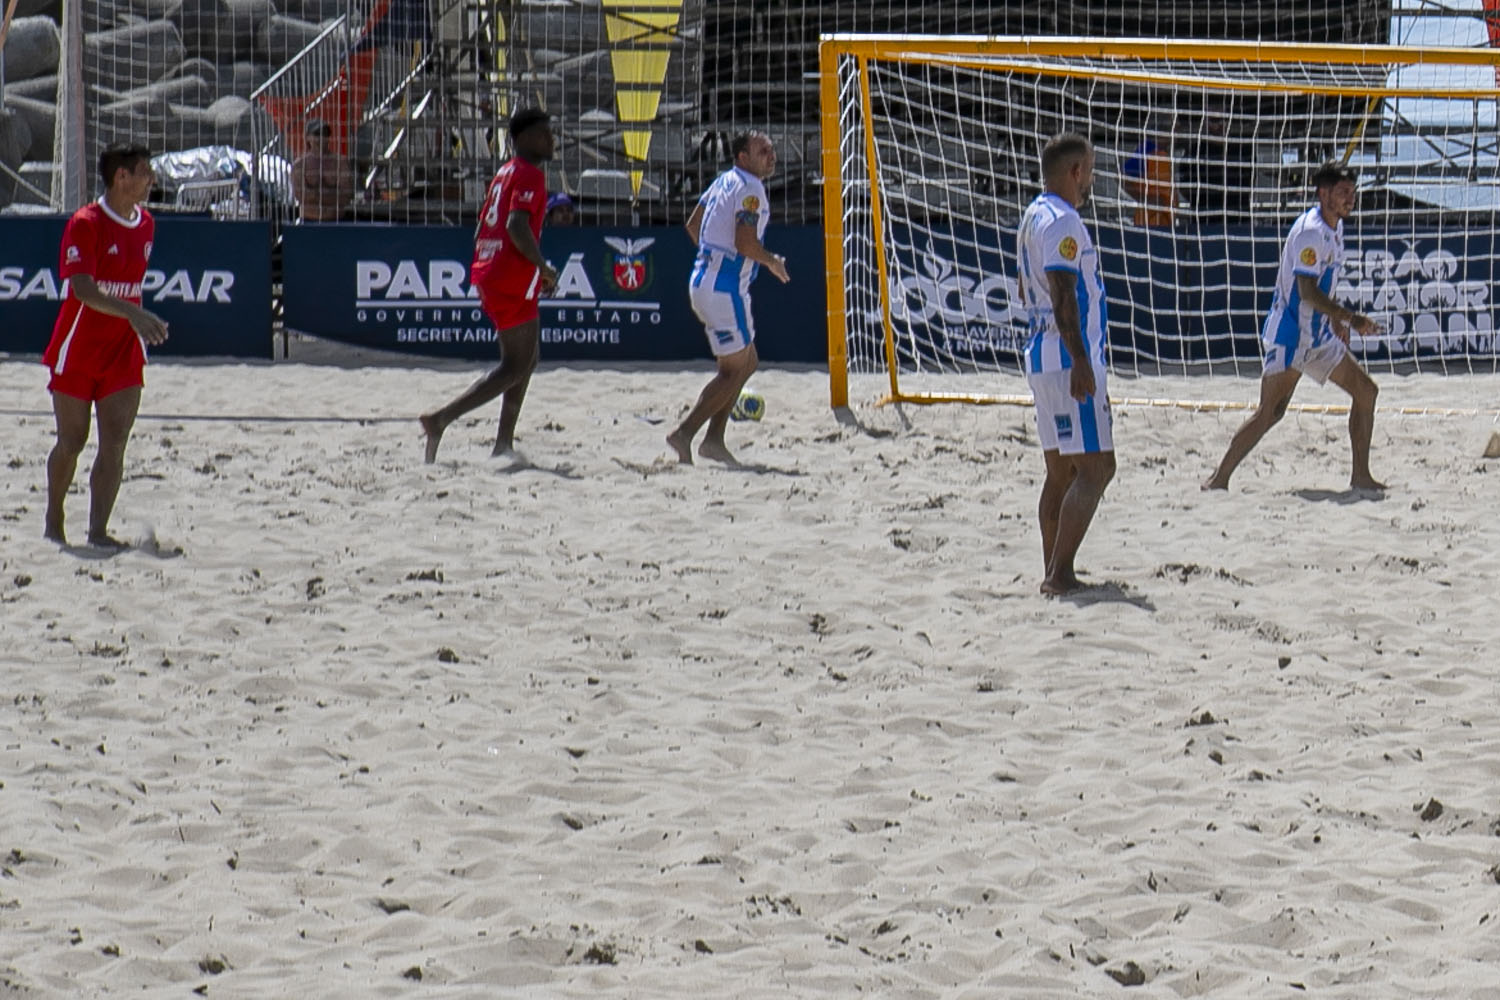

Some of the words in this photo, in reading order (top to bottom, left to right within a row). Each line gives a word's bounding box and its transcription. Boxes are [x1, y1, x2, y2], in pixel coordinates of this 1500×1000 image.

[356, 252, 596, 299] PARÁ
[1338, 239, 1458, 281] ERÃO
[0, 268, 235, 303] SAPAR
[357, 310, 482, 323] GOVERNO
[557, 311, 661, 324] ESTADO
[541, 328, 620, 344] ESPORTE
